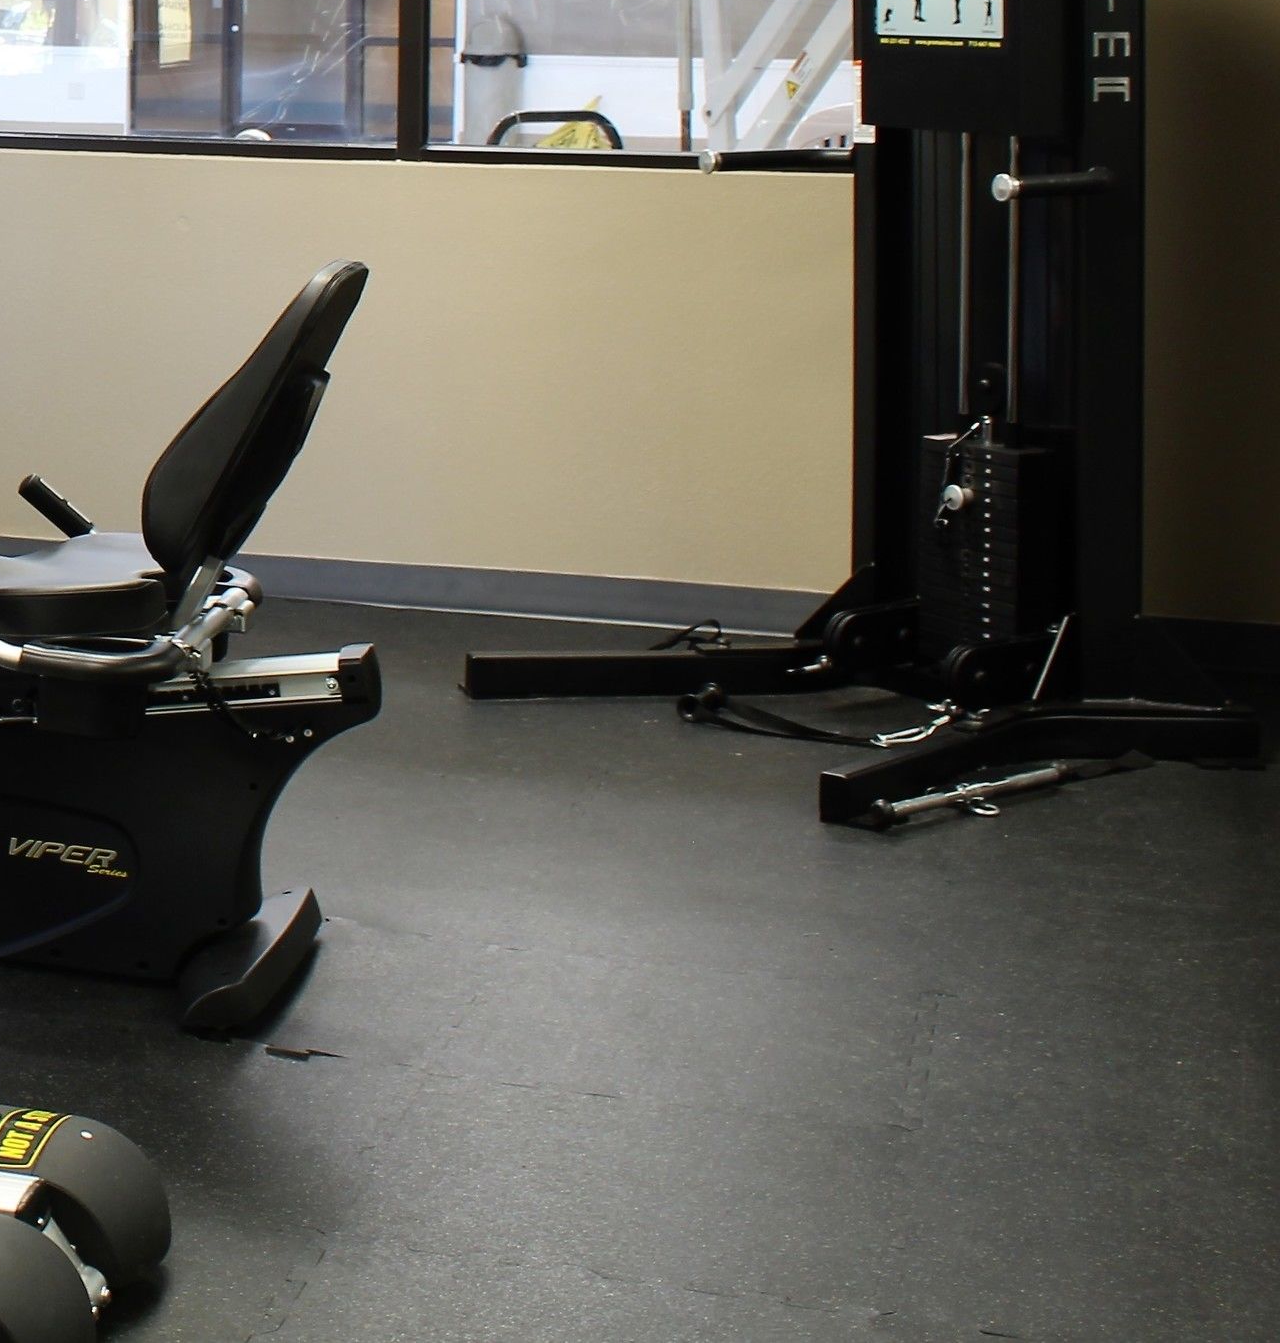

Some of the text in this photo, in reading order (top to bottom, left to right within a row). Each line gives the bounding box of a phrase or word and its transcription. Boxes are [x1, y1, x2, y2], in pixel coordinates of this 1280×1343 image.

[8, 837, 118, 868] VIPER
[86, 864, 128, 878] Series
[13, 1121, 43, 1131] A
